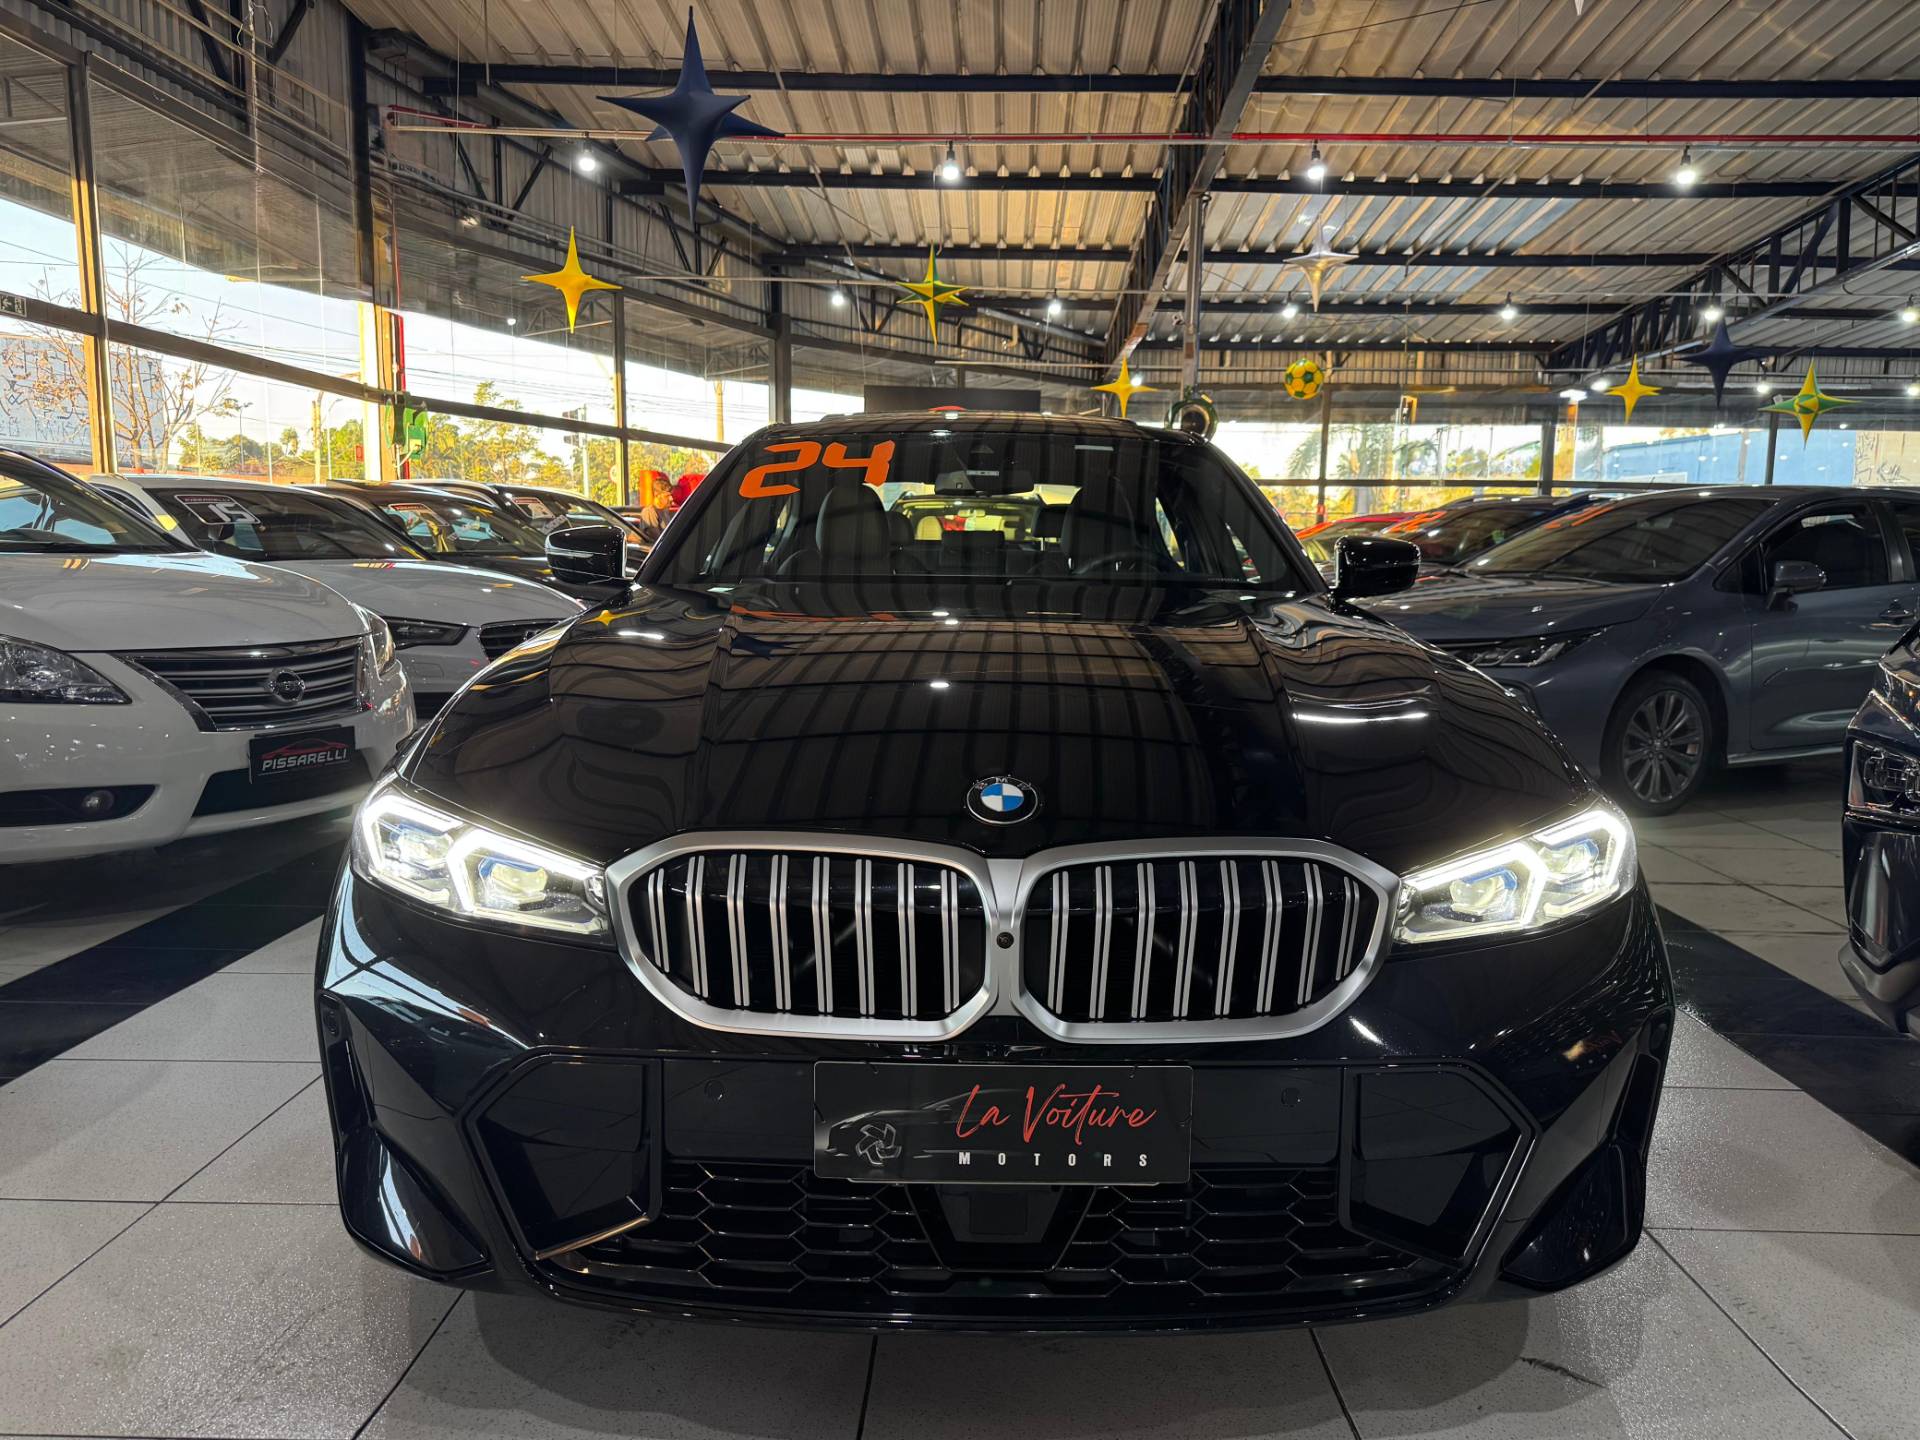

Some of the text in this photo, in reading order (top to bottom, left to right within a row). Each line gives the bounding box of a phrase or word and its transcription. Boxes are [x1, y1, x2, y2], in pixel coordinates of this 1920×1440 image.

[738, 440, 896, 499] 24
[207, 503, 255, 522] 15
[262, 748, 347, 771] PISSARELLI
[956, 1084, 1157, 1145] La Voiture
